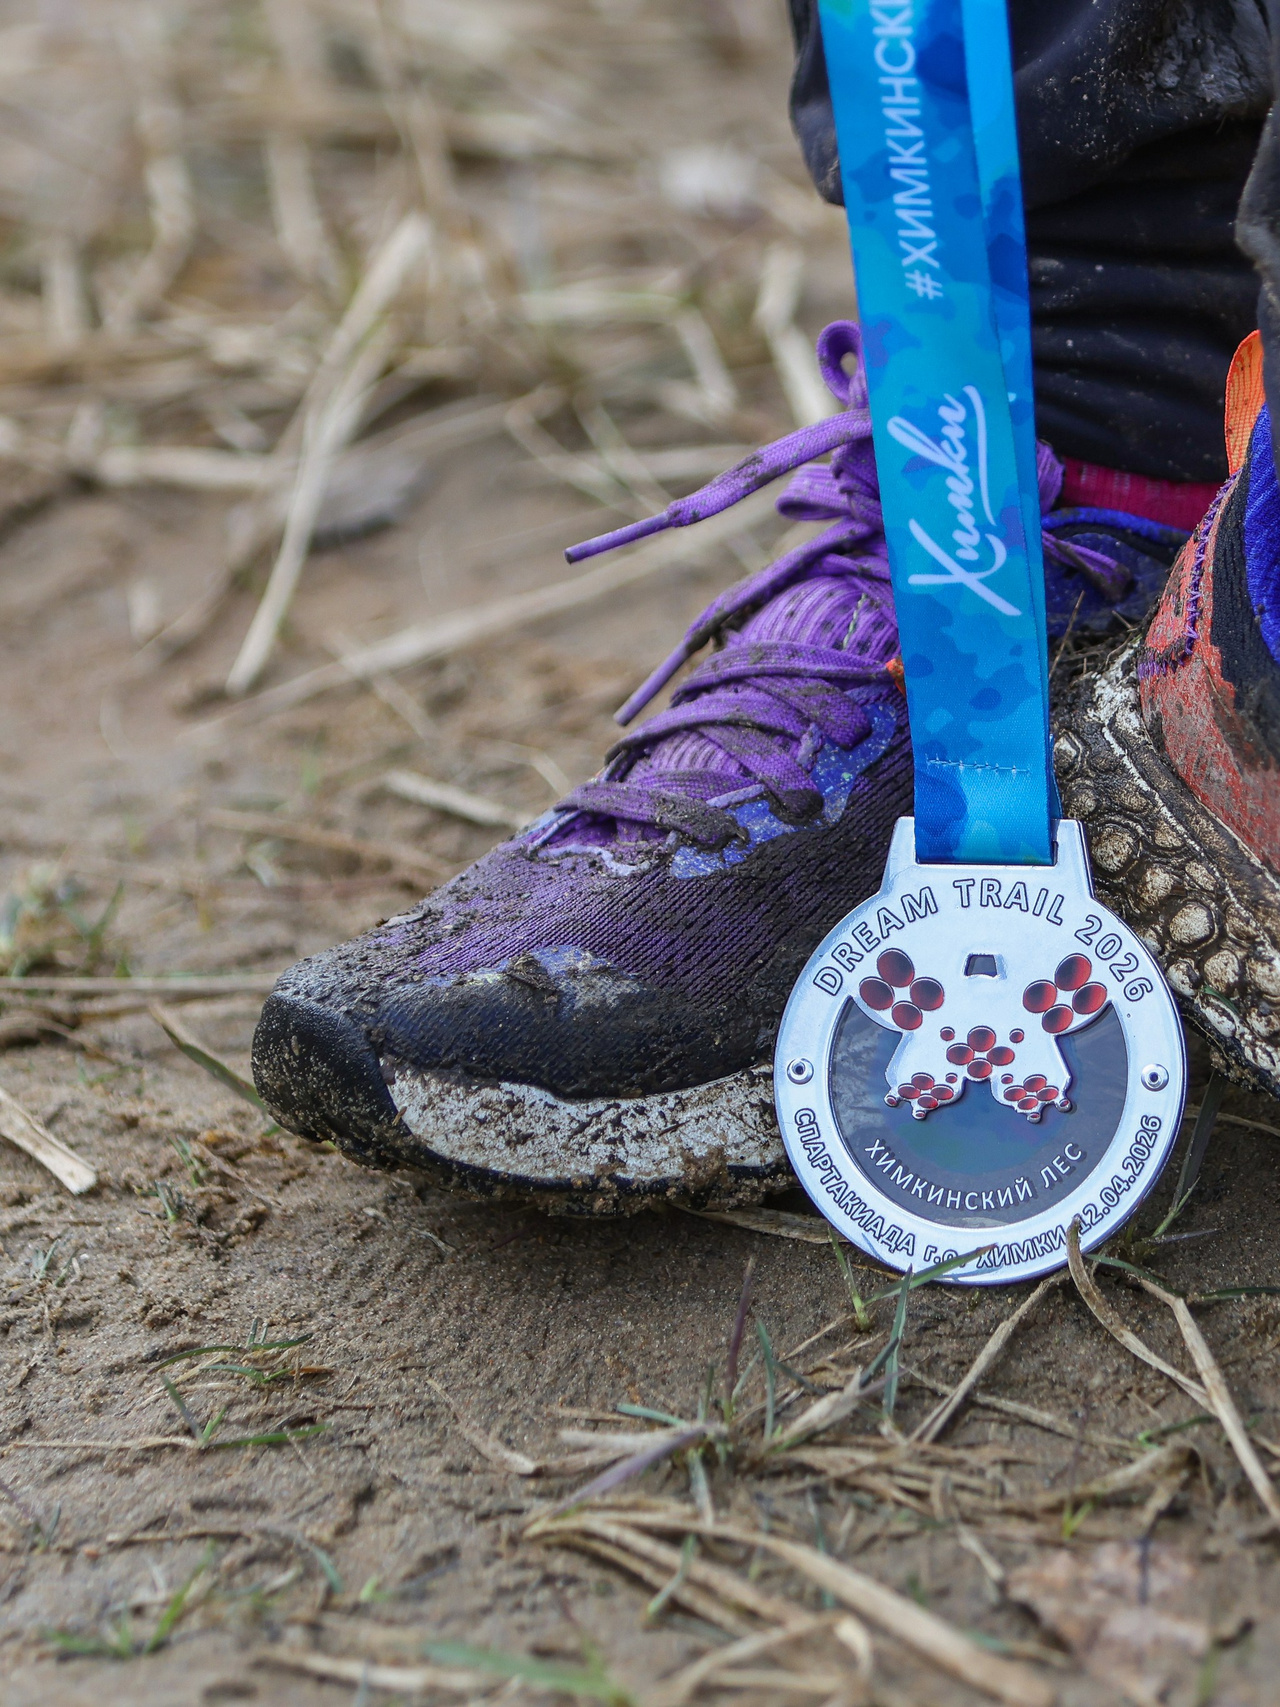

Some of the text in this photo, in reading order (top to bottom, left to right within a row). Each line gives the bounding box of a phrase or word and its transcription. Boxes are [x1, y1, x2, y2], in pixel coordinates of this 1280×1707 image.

[868, 0, 944, 300] #ХИМКИНСК
[813, 878, 1153, 1002] DREAM TRAIL 2026
[793, 1107, 915, 1256] СПАРТАКИАДА
[976, 1224, 1068, 1269] ХИМКИ
[1074, 1114, 1162, 1235] 12.04.2026
[864, 1138, 1083, 1211] ХИМКИНСКИЙ ЛЕС
